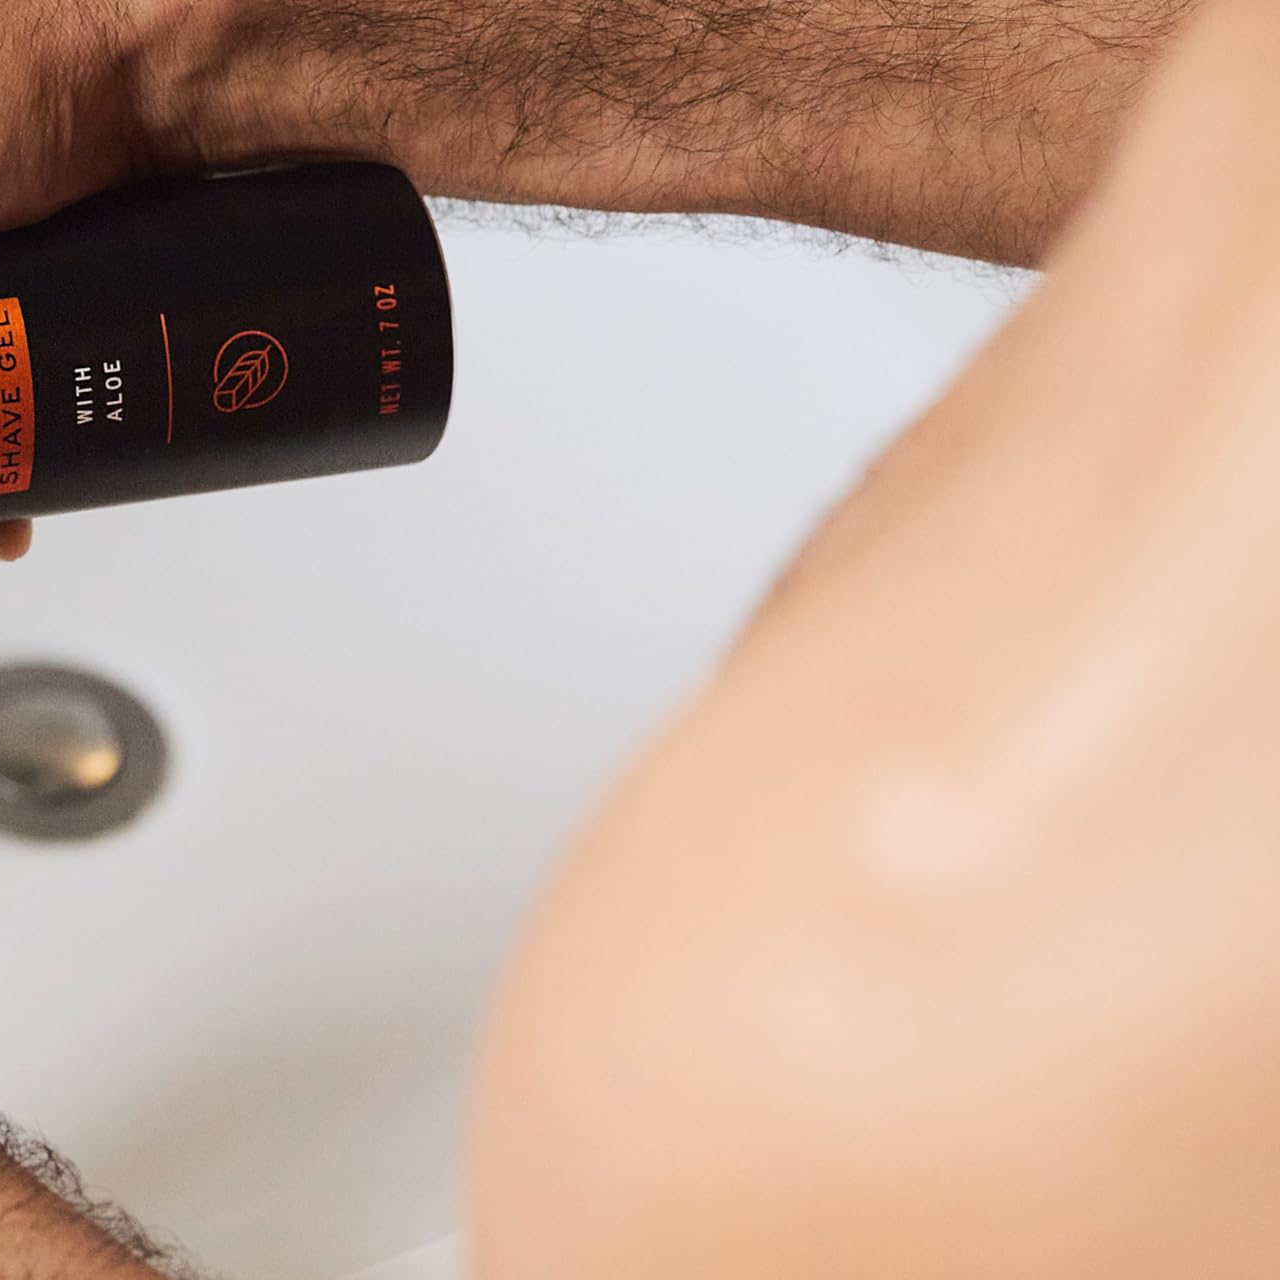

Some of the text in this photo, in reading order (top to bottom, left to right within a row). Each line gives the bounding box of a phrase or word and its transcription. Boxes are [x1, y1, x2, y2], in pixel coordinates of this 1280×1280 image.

[373, 284, 401, 414] NET WT. 7 OZ
[74, 367, 94, 425] WITH
[103, 360, 123, 422] ALOE
[0, 386, 22, 485] SHAVE
